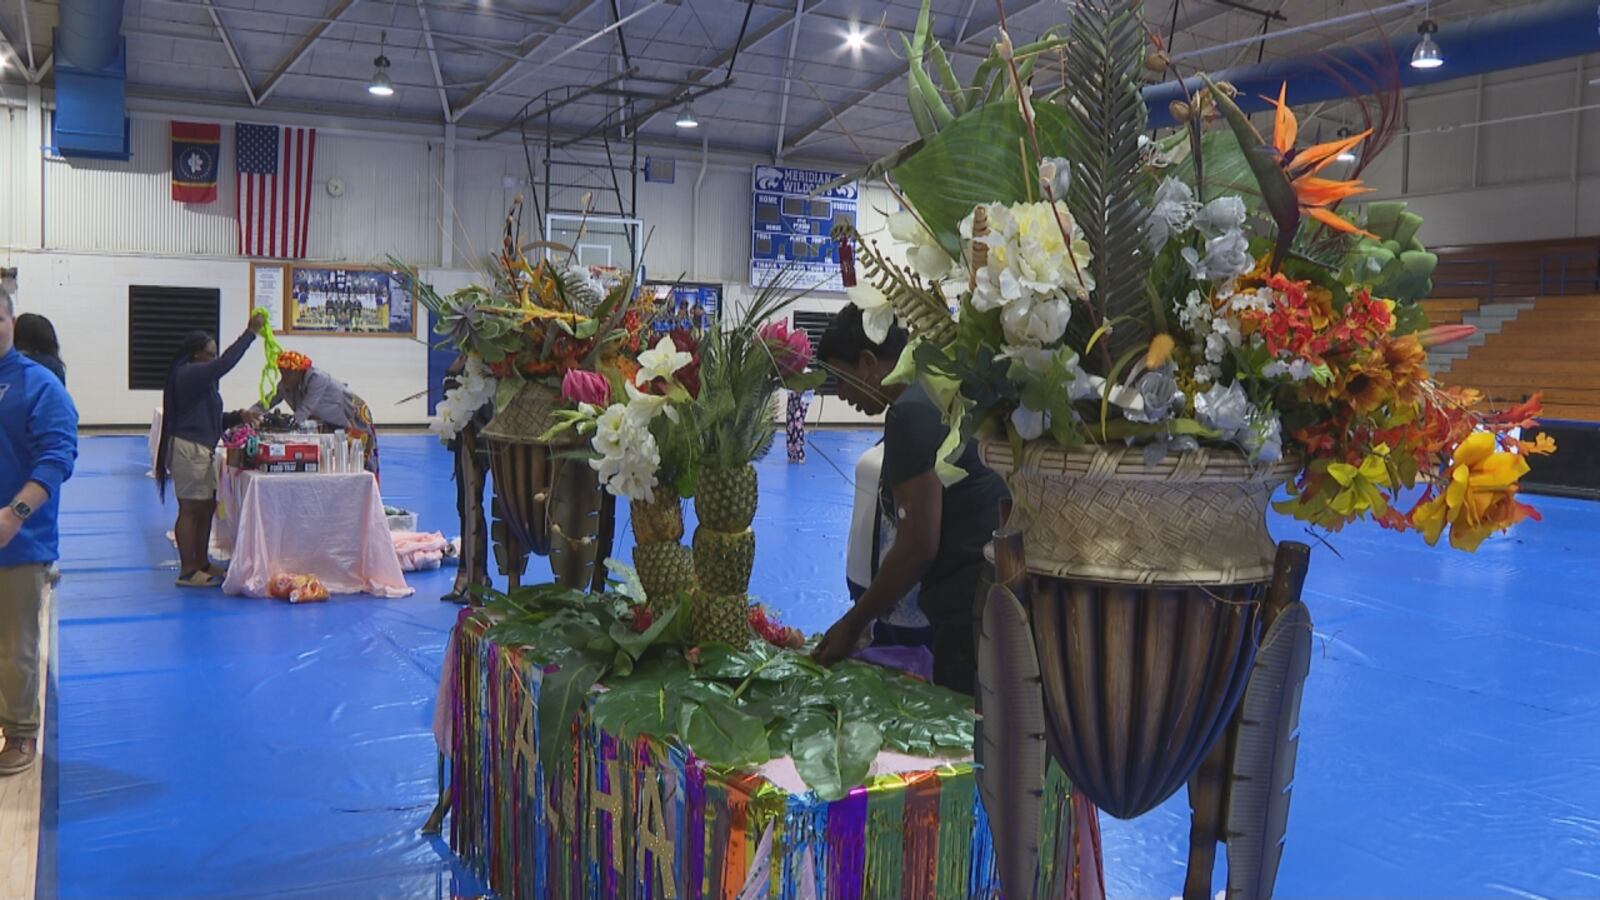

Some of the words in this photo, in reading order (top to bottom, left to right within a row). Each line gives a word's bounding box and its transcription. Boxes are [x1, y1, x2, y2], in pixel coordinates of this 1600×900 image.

[784, 170, 832, 183] MERIDIAN
[783, 182, 832, 196] WILDCS
[758, 195, 778, 204] HOME
